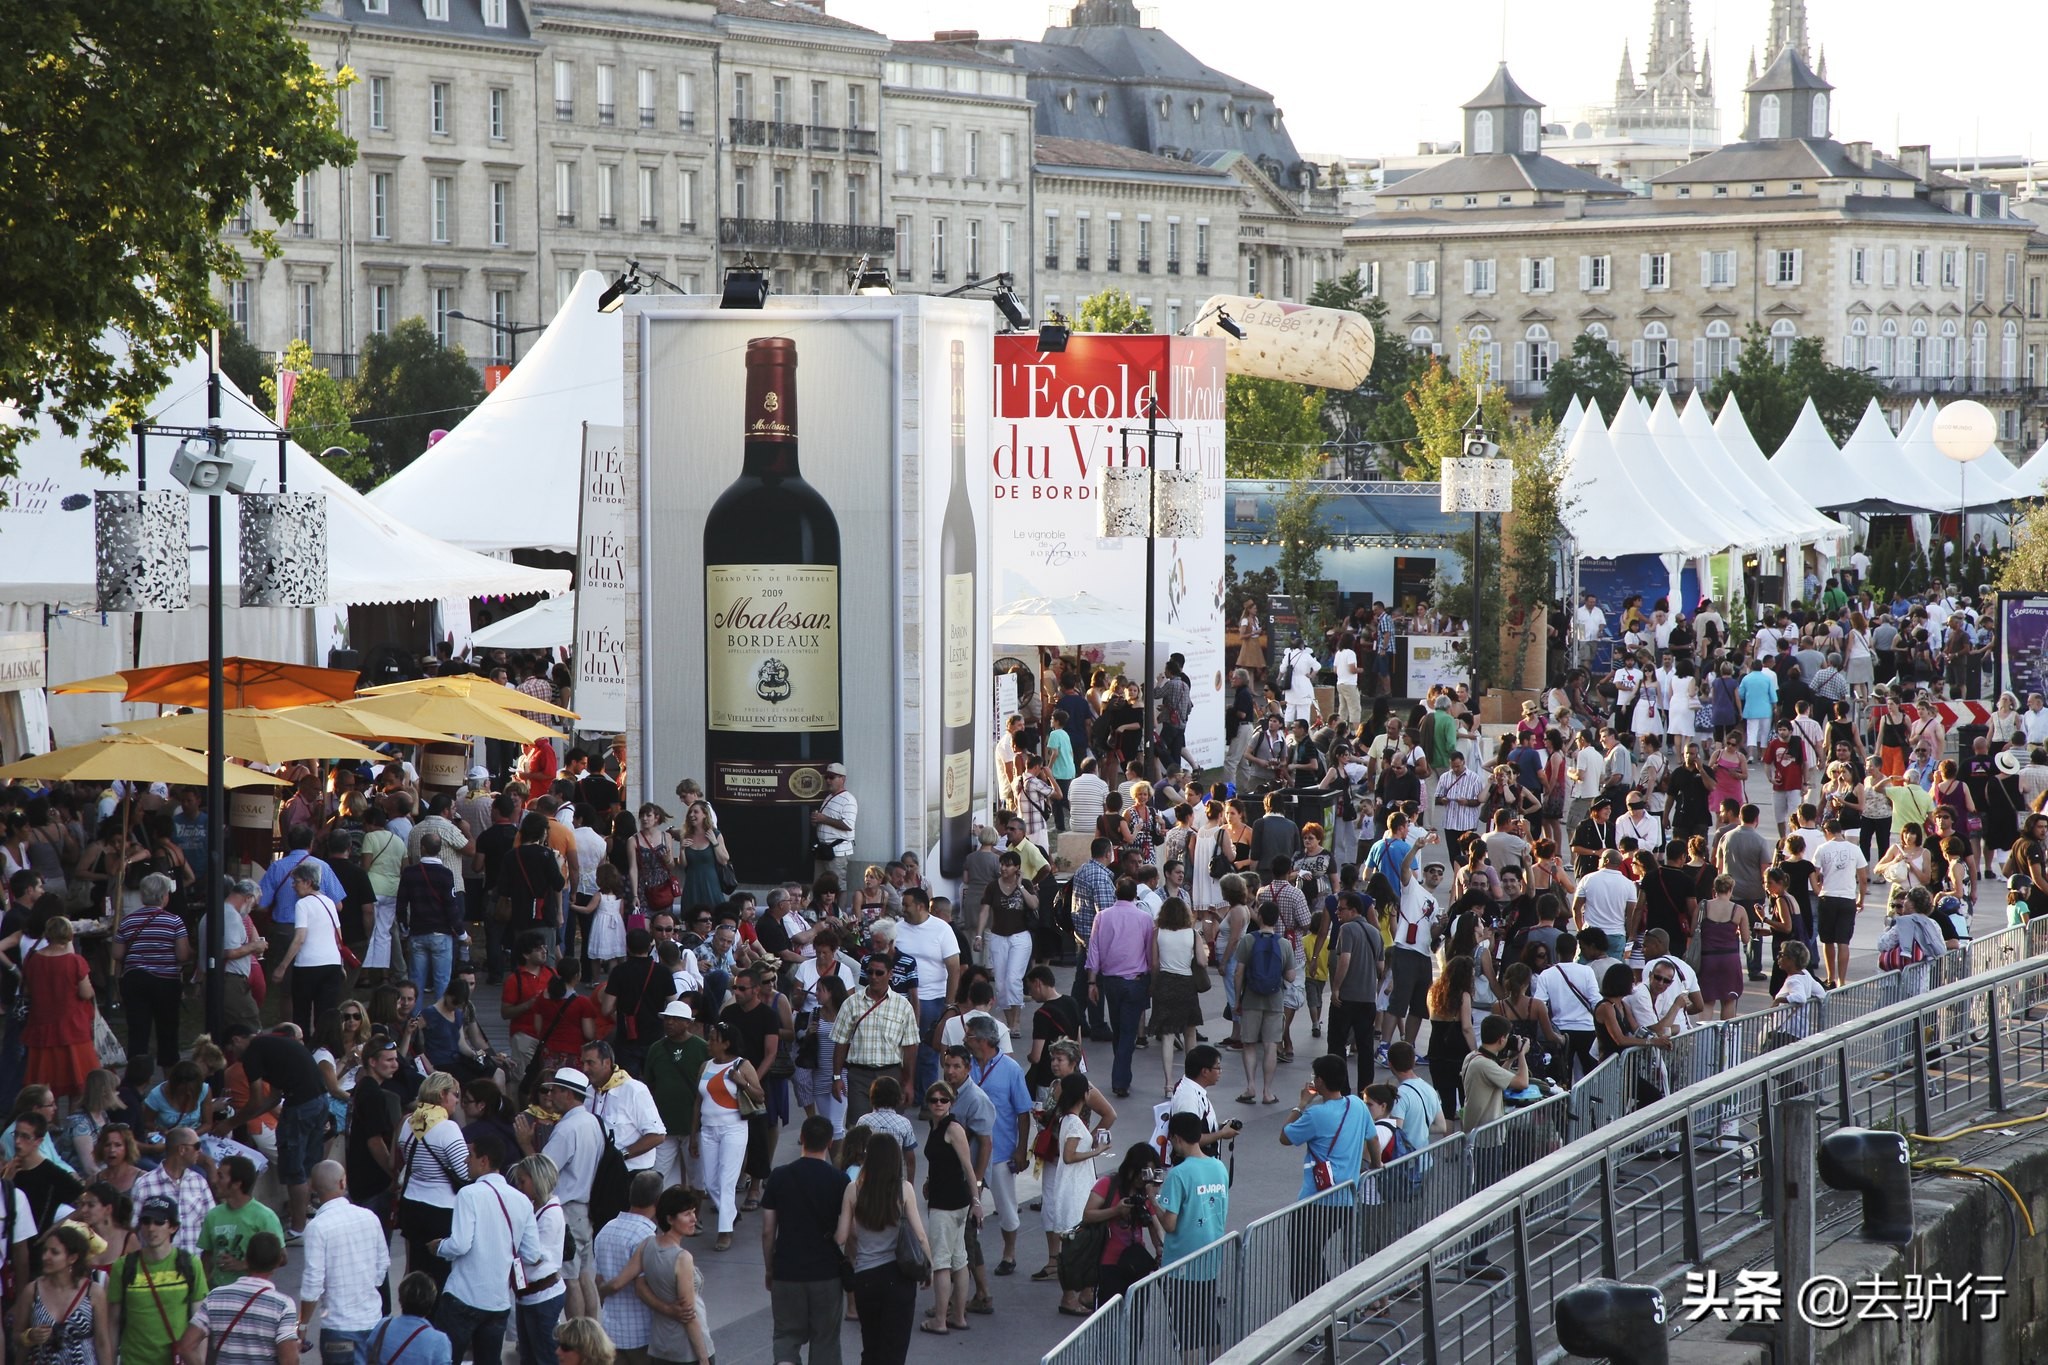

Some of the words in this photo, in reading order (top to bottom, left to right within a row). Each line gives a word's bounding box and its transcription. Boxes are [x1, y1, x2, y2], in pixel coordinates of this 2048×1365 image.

[1259, 311, 1302, 333] liège
[993, 350, 1159, 419] l'École
[993, 423, 1053, 480] du
[592, 473, 614, 496] du
[995, 485, 1019, 499] DE
[1013, 529, 1025, 539] Le
[1028, 529, 1066, 541] vignoble
[588, 558, 610, 581] du
[761, 589, 783, 598] 2009
[713, 597, 831, 630] Malesan
[727, 634, 820, 648] BORDEAUX
[584, 653, 606, 676] du
[1651, 1295, 1666, 1325] 5
